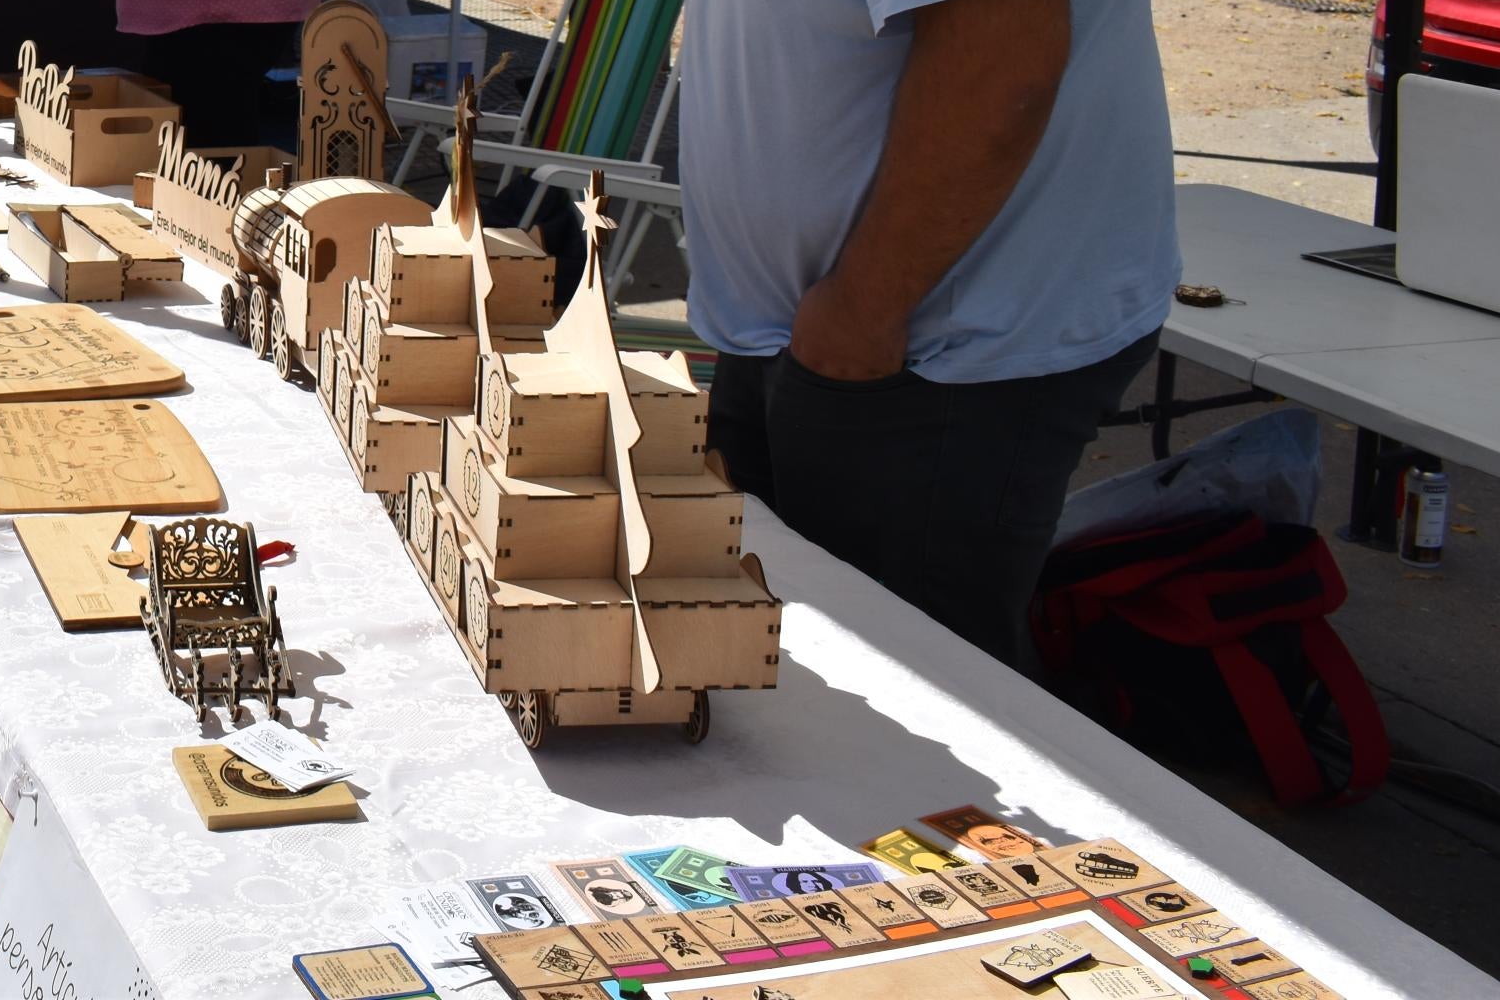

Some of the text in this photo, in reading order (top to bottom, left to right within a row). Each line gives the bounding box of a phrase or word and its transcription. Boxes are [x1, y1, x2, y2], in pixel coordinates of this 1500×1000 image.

[158, 120, 244, 210] Mamá
[157, 211, 235, 269] Eres la mejor del mundo
[492, 389, 500, 421] 2
[467, 465, 478, 504] 12
[442, 543, 454, 586] 20
[1132, 967, 1164, 993] SUERTE
